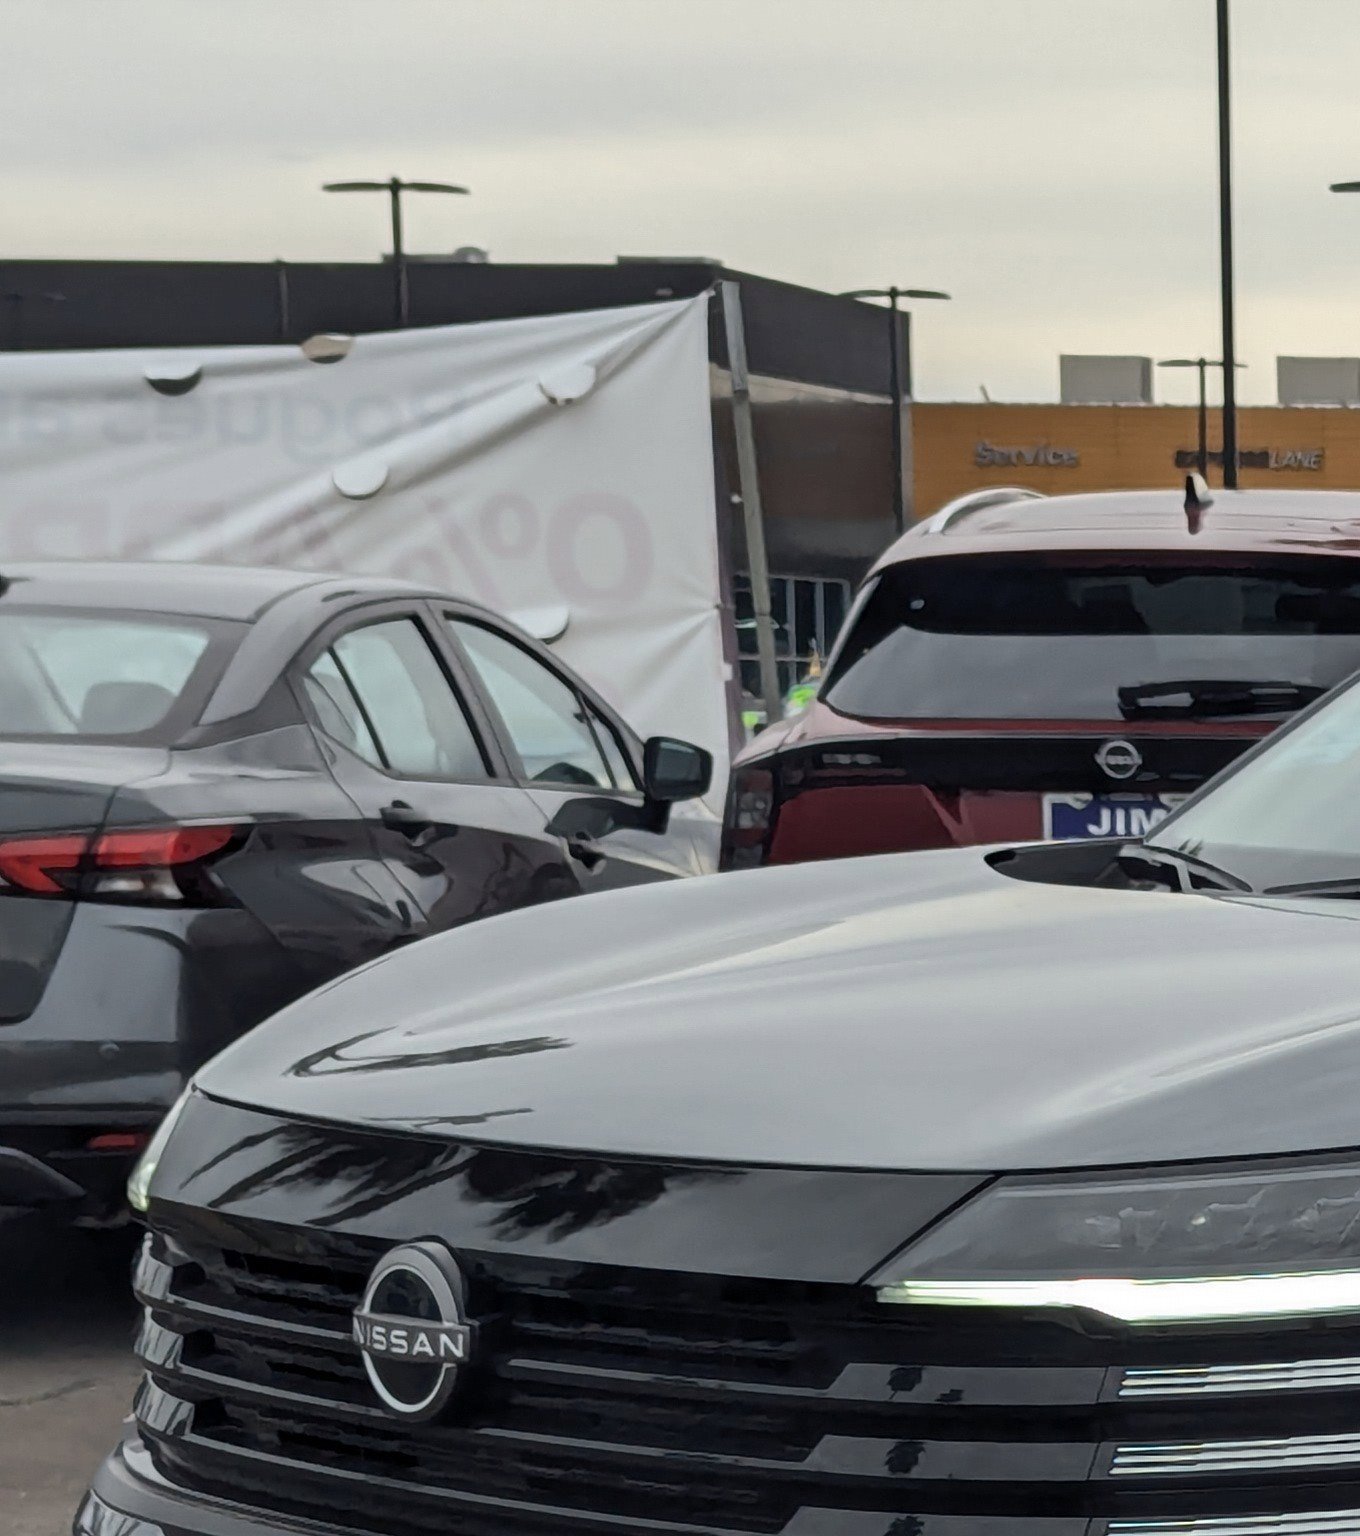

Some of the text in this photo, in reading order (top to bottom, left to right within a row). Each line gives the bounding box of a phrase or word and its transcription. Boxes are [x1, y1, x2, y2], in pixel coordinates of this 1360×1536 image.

[975, 439, 1079, 468] Service
[1268, 448, 1325, 470] LANE
[1086, 806, 1168, 836] JIM
[352, 1315, 465, 1359] NISSAN
